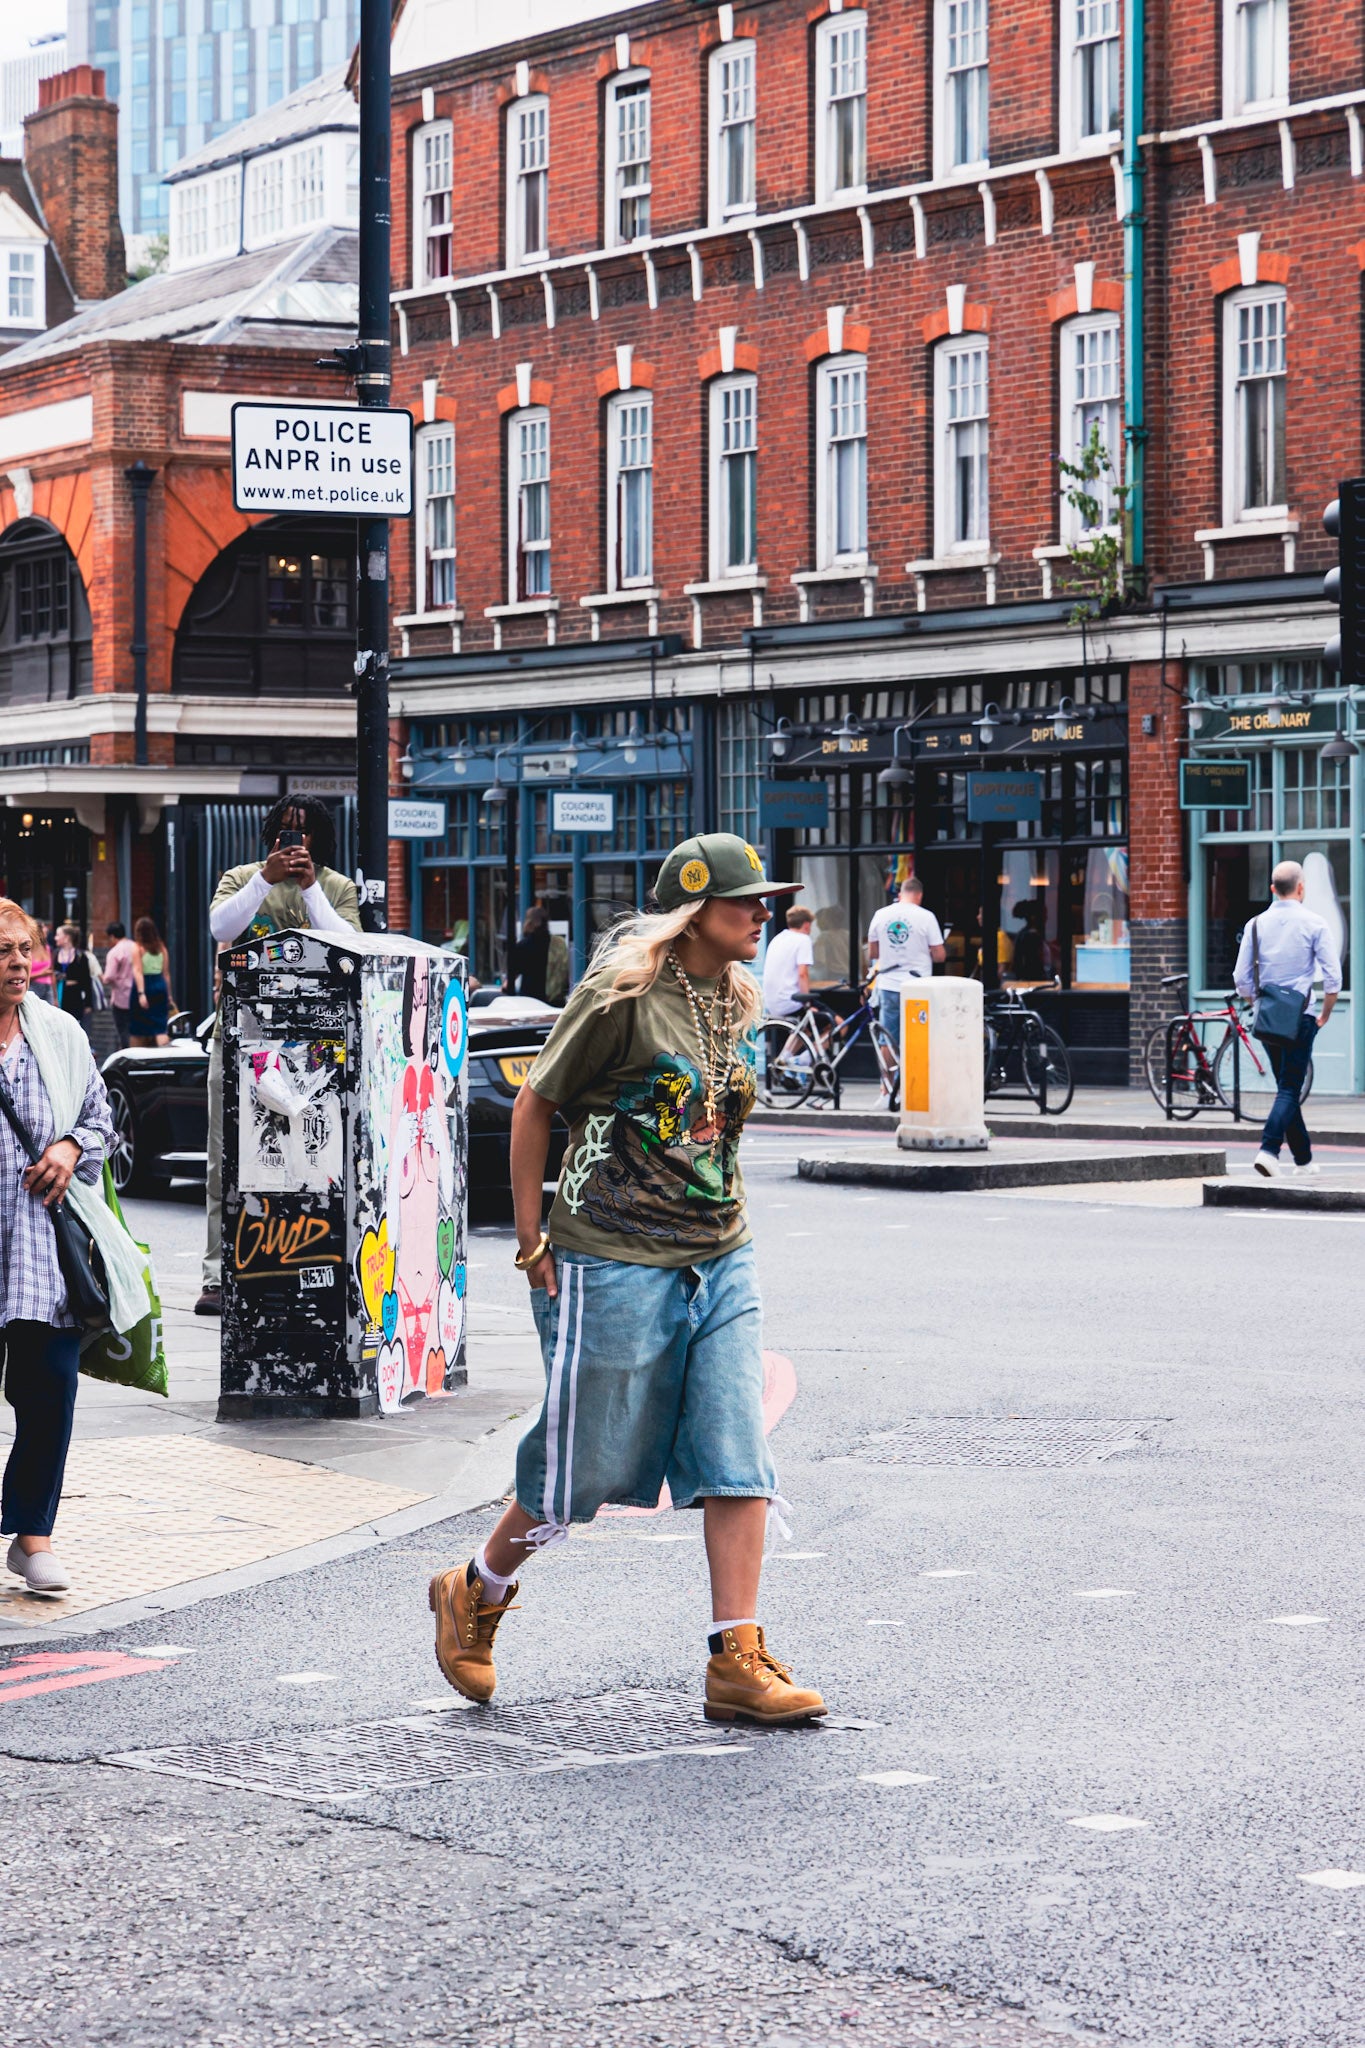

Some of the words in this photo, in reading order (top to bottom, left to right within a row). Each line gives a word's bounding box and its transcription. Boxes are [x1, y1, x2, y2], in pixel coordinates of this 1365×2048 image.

[275, 419, 372, 444] POLICE
[245, 448, 320, 471] ANPR
[331, 451, 351, 472] in
[362, 458, 401, 474] use
[243, 486, 404, 503] www.met.police.uk
[1230, 715, 1252, 730] THE
[1253, 712, 1311, 729] ORNARY
[302, 780, 337, 790] OTHER
[394, 808, 437, 819] COLORFUL
[561, 801, 605, 811] COLORFUL
[393, 820, 438, 830] STANDARD
[560, 813, 606, 823] STANDARD
[366, 1241, 388, 1279] TRUST
[373, 1273, 385, 1300] ME
